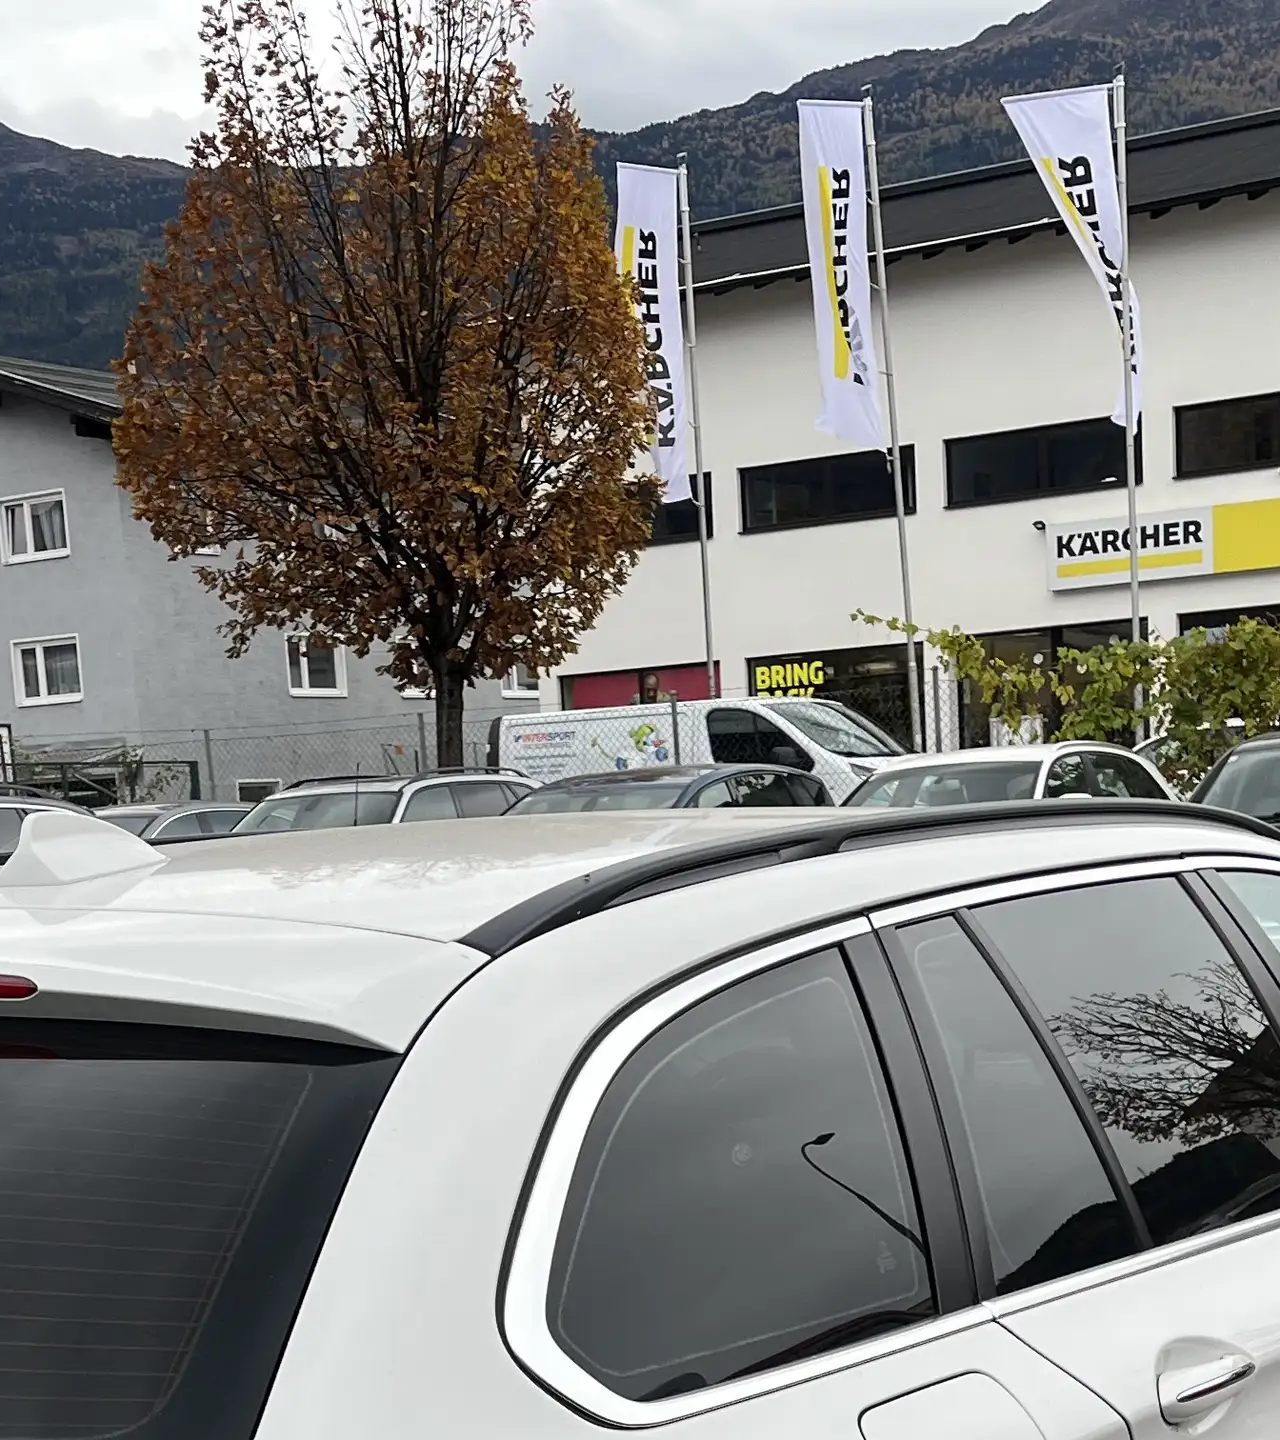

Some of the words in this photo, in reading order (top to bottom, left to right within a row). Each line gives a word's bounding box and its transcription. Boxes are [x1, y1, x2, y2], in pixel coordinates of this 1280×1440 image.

[1056, 519, 1203, 559] KÄRCHER
[755, 660, 825, 690] BRING
[522, 731, 577, 743] INTERSPORT
